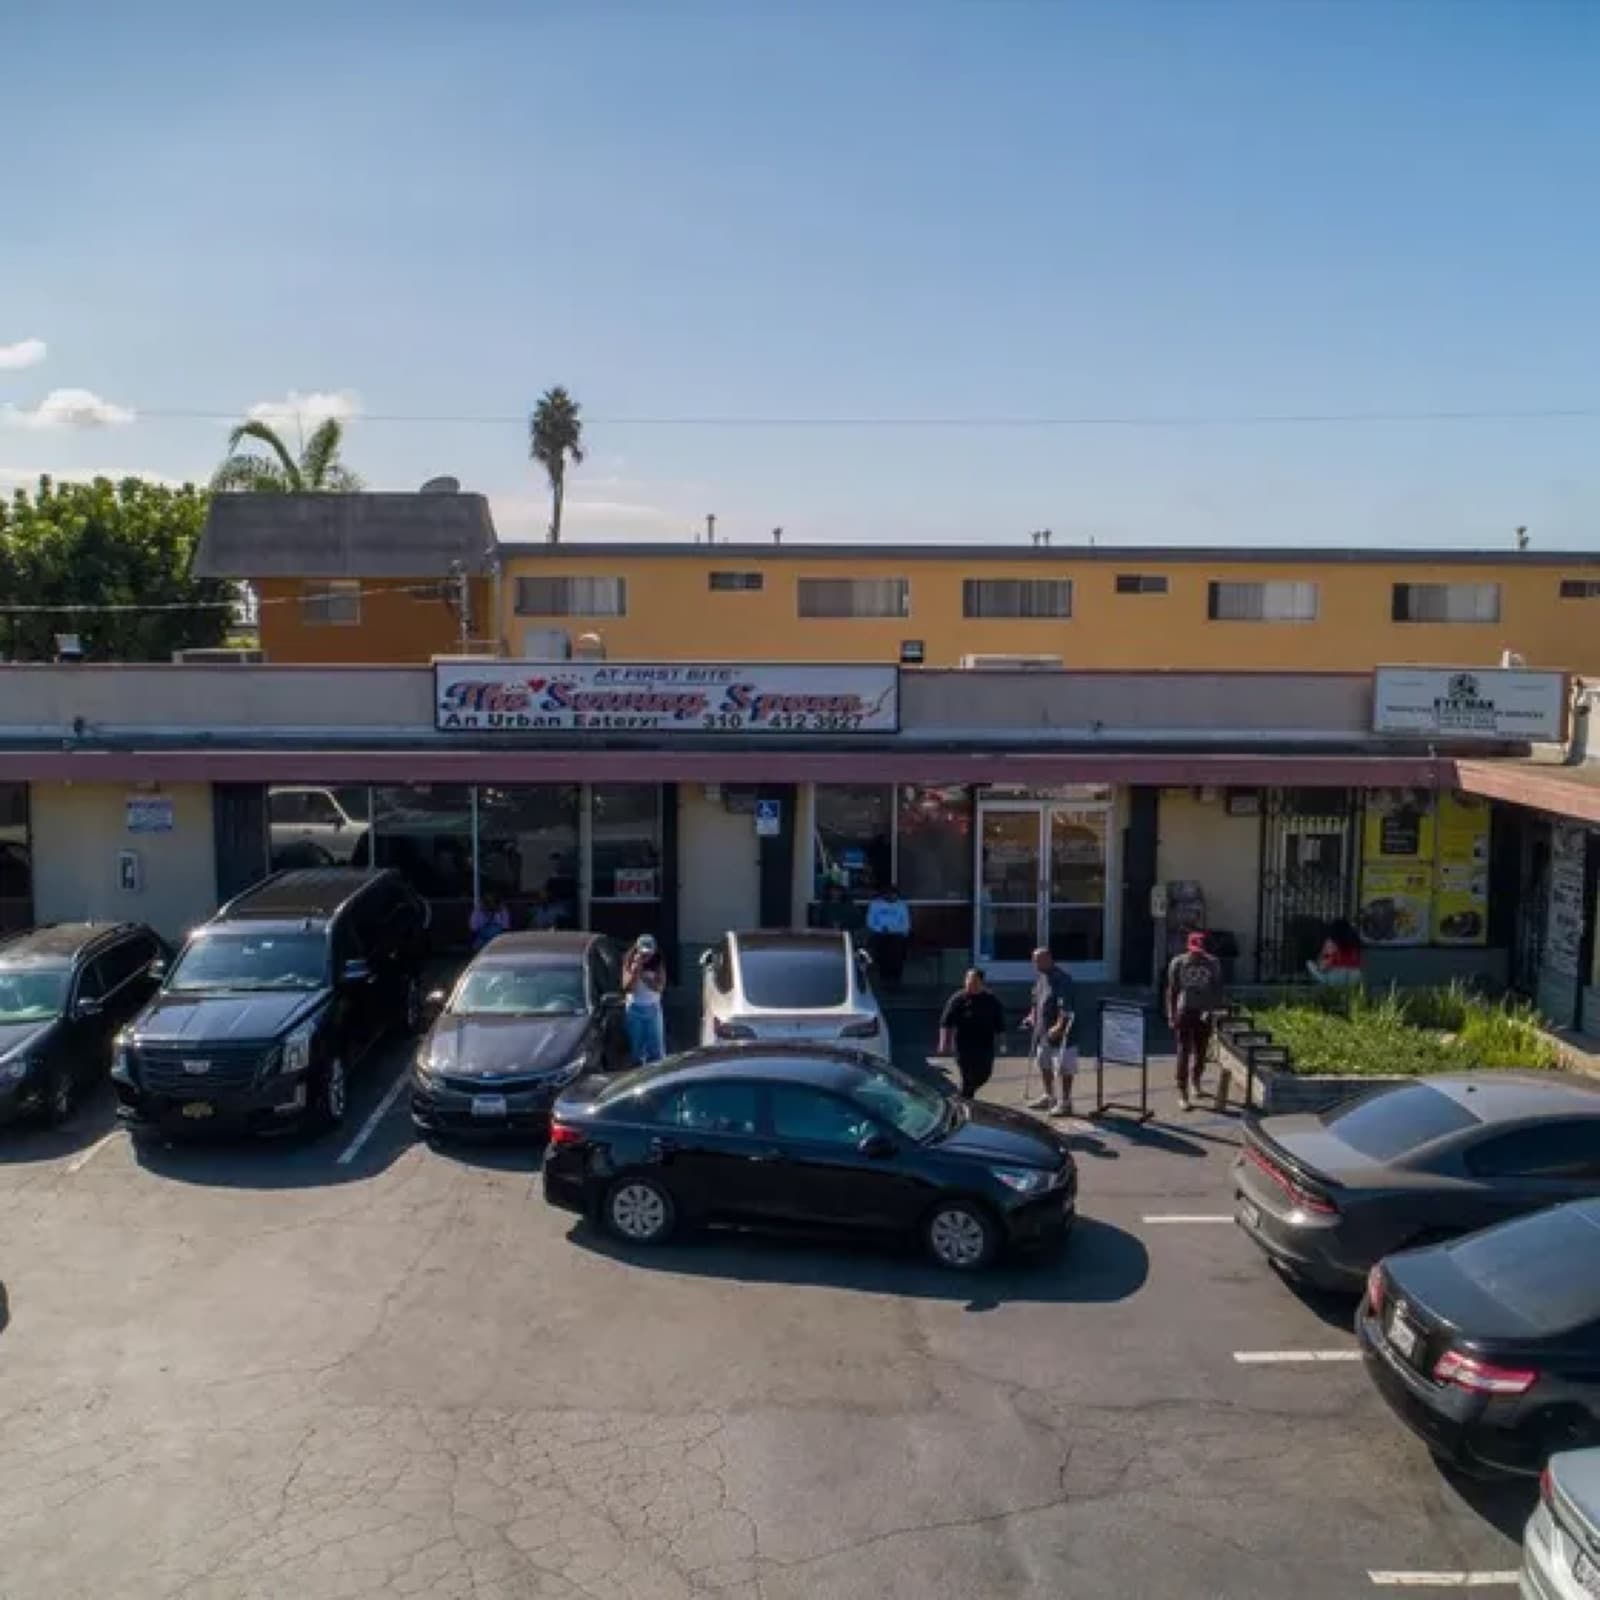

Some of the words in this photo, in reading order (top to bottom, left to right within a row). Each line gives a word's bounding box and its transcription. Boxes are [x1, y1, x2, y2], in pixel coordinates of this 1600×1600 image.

[445, 713, 478, 727] An
[488, 713, 561, 727] Urban
[702, 713, 743, 728] 310
[768, 713, 807, 728] 412
